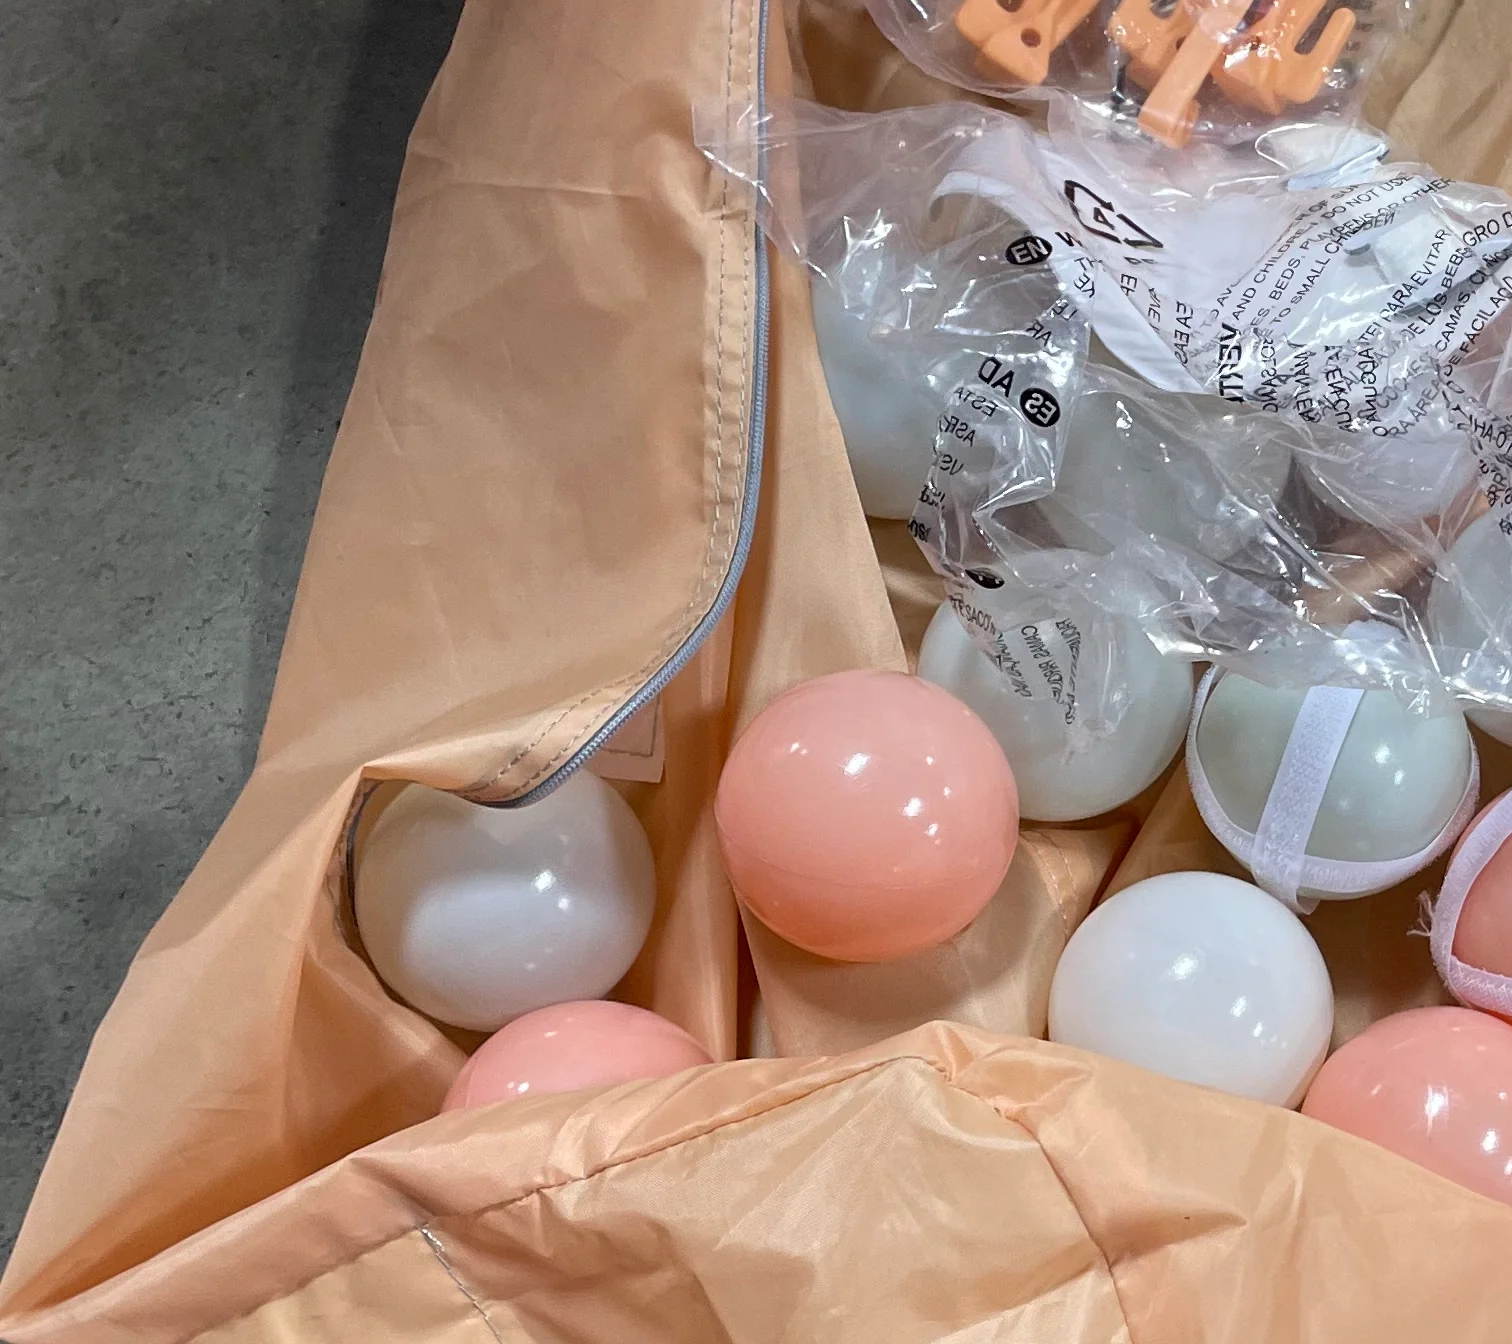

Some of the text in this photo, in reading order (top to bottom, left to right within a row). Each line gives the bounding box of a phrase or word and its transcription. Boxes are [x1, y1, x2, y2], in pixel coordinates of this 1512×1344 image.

[1011, 238, 1049, 264] EN
[1232, 287, 1257, 321] AND
[1349, 189, 1381, 208] NOT
[1410, 228, 1450, 287] EVITAR
[1290, 257, 1331, 305] SMALL
[1418, 292, 1448, 326] LOS
[1459, 307, 1497, 354] FÁCIL
